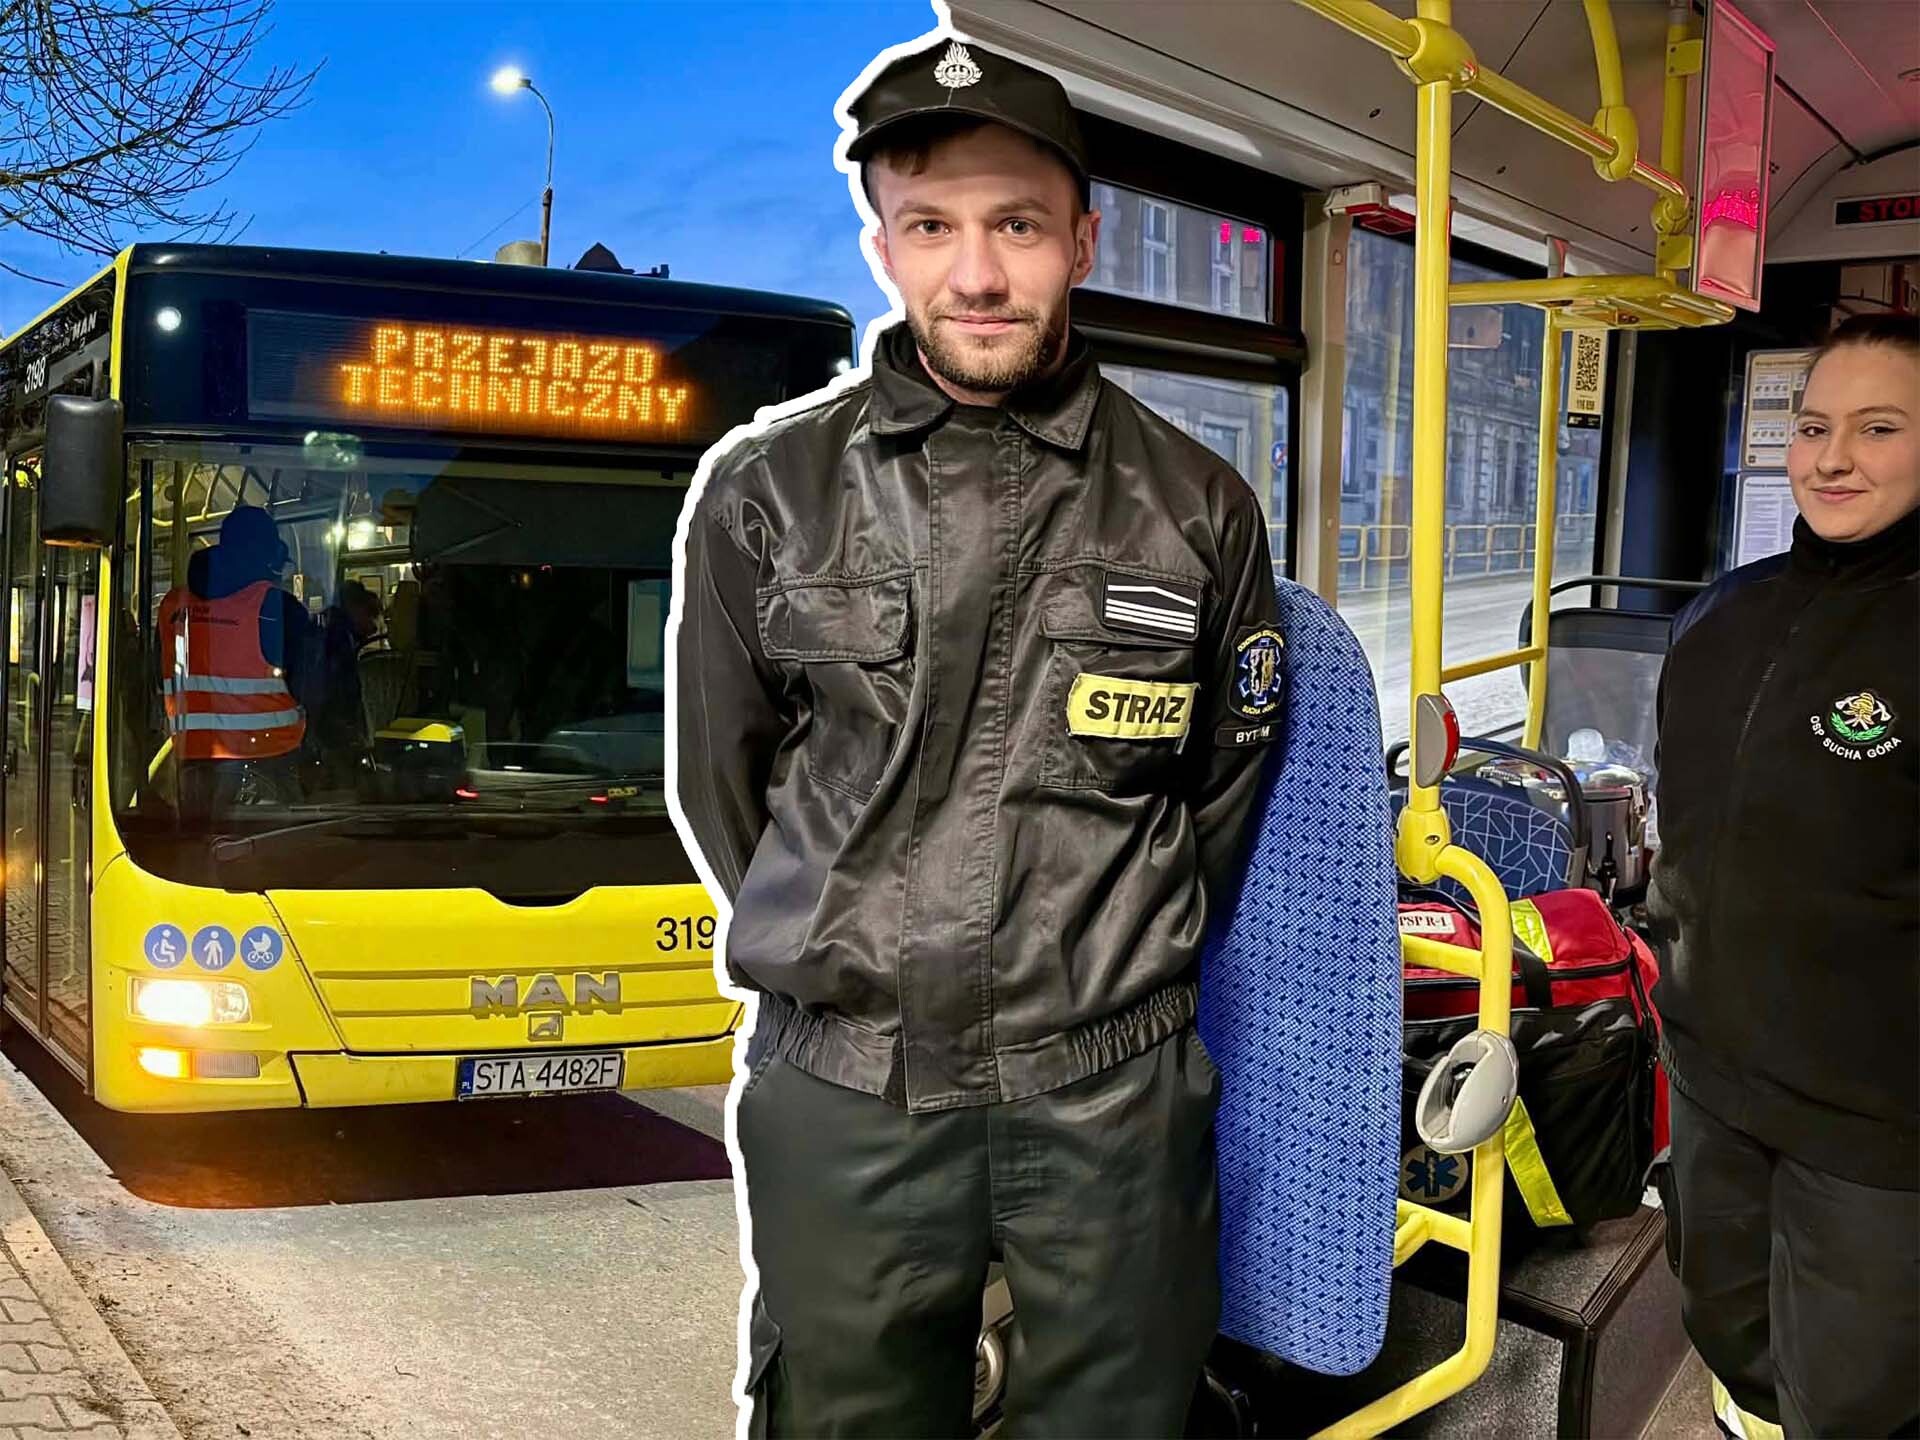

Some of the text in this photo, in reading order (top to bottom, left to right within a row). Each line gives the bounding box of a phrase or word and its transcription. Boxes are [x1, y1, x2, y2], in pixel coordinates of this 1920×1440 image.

[24, 356, 46, 395] 3198
[375, 327, 656, 383] PRZEJAZD
[340, 364, 688, 424] TECHNICZNY
[1236, 725, 1271, 743] BYTM
[1810, 715, 1825, 736] OSP
[1822, 737, 1862, 760] SUCHA
[470, 971, 622, 1013] MAN
[476, 1060, 526, 1091] STA
[535, 1056, 618, 1088] 4482F
